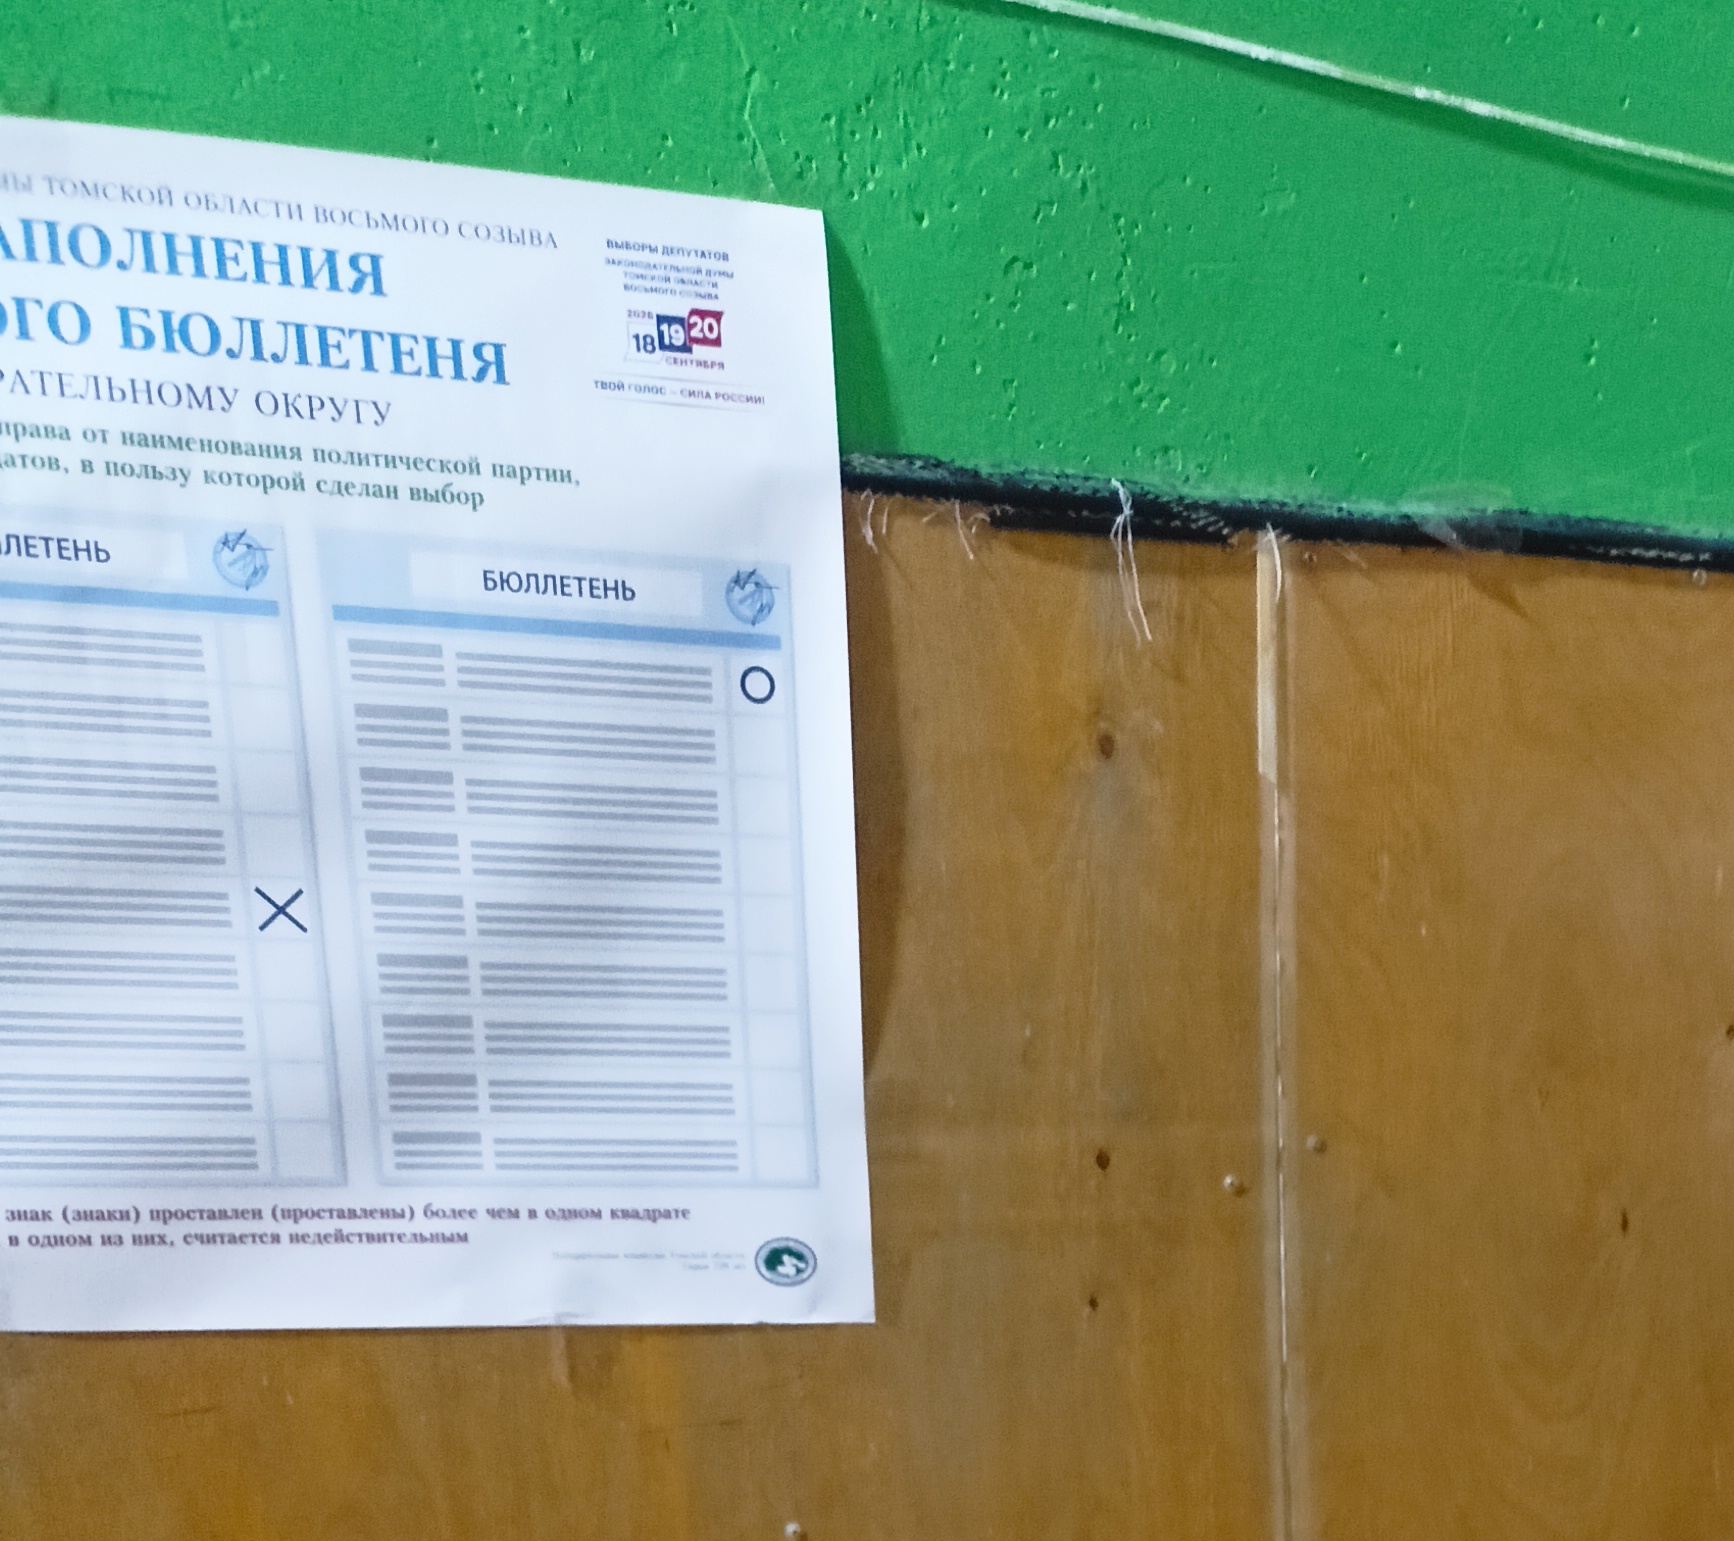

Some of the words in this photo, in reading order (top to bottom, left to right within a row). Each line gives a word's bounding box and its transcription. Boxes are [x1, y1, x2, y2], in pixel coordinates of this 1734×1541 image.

[41, 174, 175, 208] ТОМСКОЙ
[183, 190, 304, 222] ОБЛАСТИ
[314, 204, 450, 238] ВОСЬМОГО
[457, 219, 560, 250] СОЗЫВА
[606, 238, 658, 254] ВЫБОРЫ
[661, 245, 729, 262] ДЕПУТАТОВ
[0, 296, 92, 346] ГО
[115, 304, 511, 387] БЮЛЛЕТЕНЯ
[632, 333, 657, 355] 18
[659, 323, 686, 347] 19
[689, 315, 719, 340] 20
[0, 369, 239, 414] АТЕЛЬНОМУ
[254, 389, 393, 427] ОКРУГУ
[593, 379, 626, 393] ТВОЙ
[0, 421, 72, 443] права
[82, 427, 110, 444] от
[120, 429, 303, 461] наименования
[312, 443, 482, 477] политической
[491, 459, 581, 486] партии,
[0, 453, 70, 475] атов,
[80, 458, 95, 475] в
[104, 460, 192, 489] пользу
[203, 467, 306, 495] которой
[316, 477, 400, 502] сделан
[408, 482, 486, 512] выбор
[0, 533, 112, 564] ЛЕТЕНЬ
[482, 569, 637, 602] БЮЛЛЕТЕНЬ
[5, 1206, 53, 1223] знак
[61, 1204, 142, 1225] (знаки)
[149, 1206, 264, 1226] проставлен
[270, 1203, 416, 1229] (проставлены)
[422, 1202, 479, 1221] более
[485, 1206, 521, 1221] чем
[526, 1207, 539, 1221] в
[544, 1207, 604, 1222] одном
[609, 1206, 692, 1224] квадрате
[8, 1233, 20, 1248] в
[27, 1232, 93, 1248] одном
[99, 1232, 124, 1247] из
[131, 1231, 175, 1248] них,
[182, 1230, 282, 1247] считается
[288, 1228, 470, 1246] недействительным
